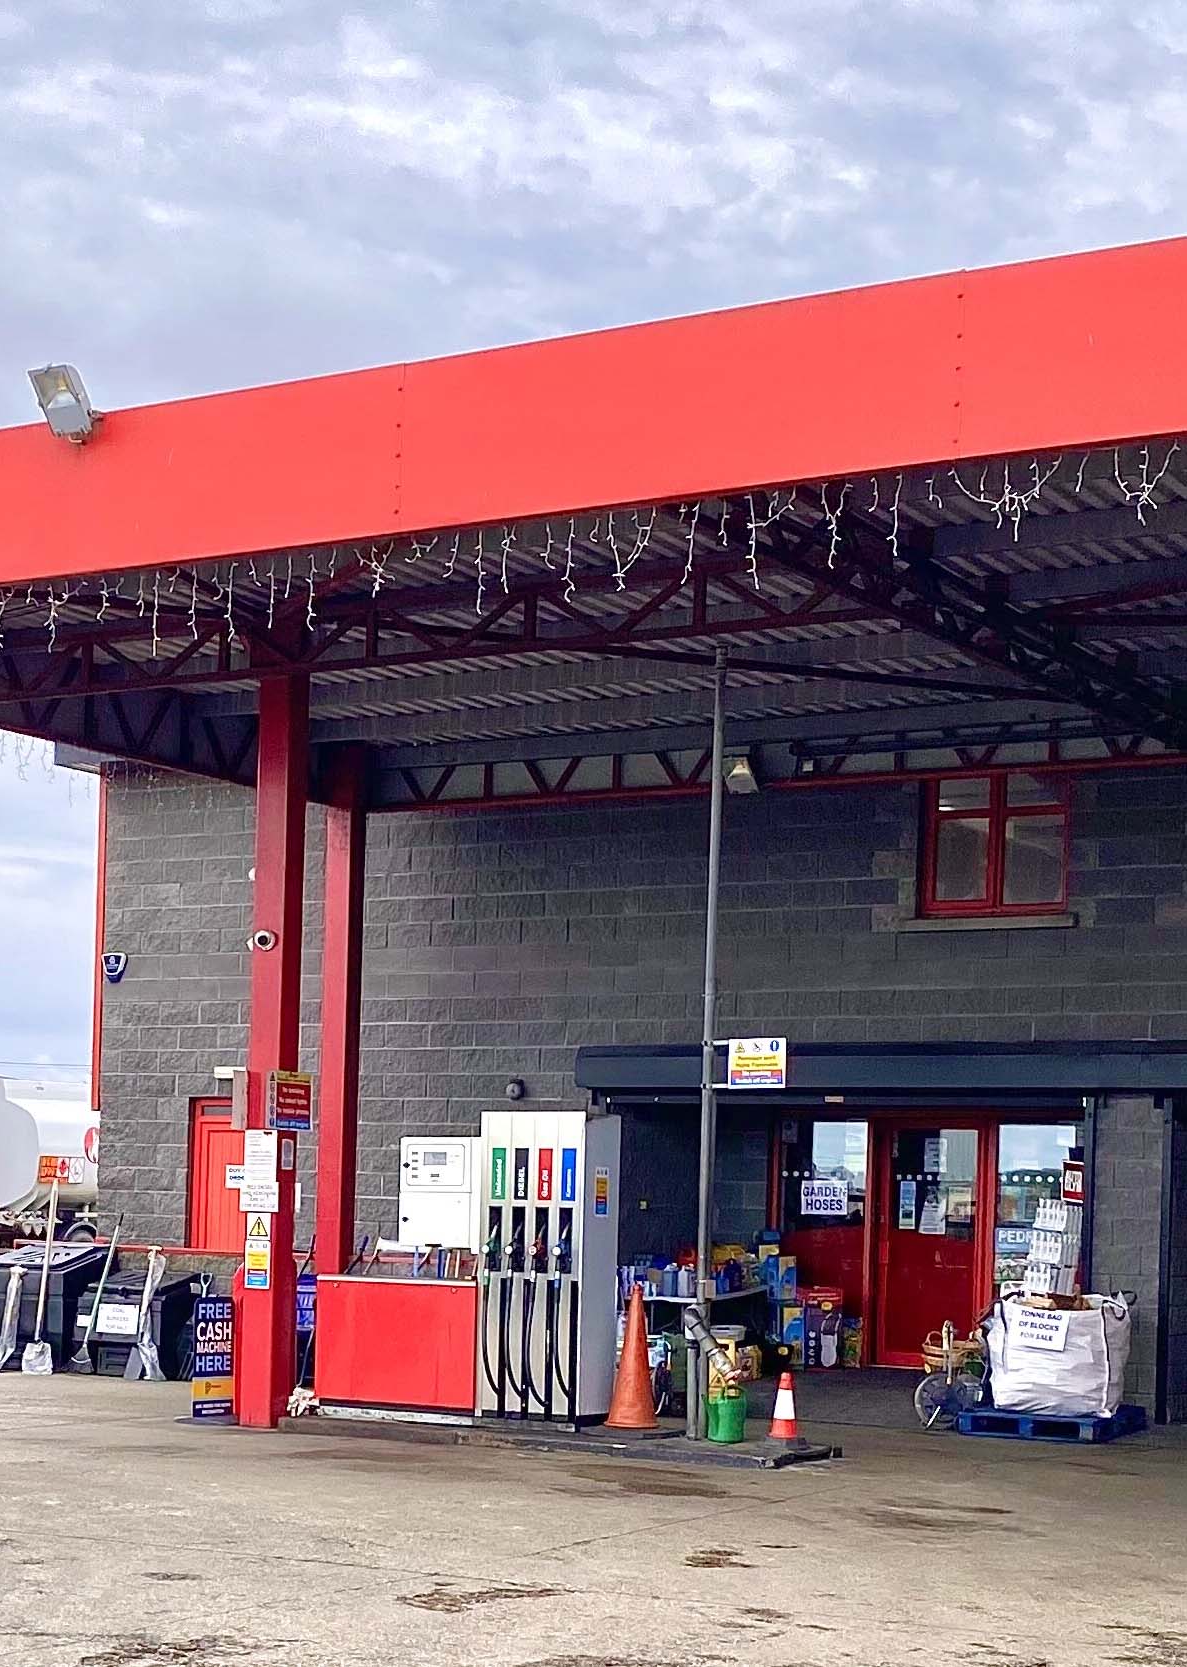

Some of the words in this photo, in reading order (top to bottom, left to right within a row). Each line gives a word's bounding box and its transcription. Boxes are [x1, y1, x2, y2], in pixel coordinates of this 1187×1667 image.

[517, 1166, 526, 1197] DIESEL
[540, 1182, 549, 1198] Gas
[803, 1186, 847, 1197] GARDEN
[805, 1198, 843, 1211] HOSES
[198, 1302, 232, 1320] FREE
[196, 1321, 233, 1341] CASH
[1030, 1321, 1060, 1332] BLOCKS
[196, 1340, 232, 1354] MACHINE
[195, 1354, 231, 1372] HERE
